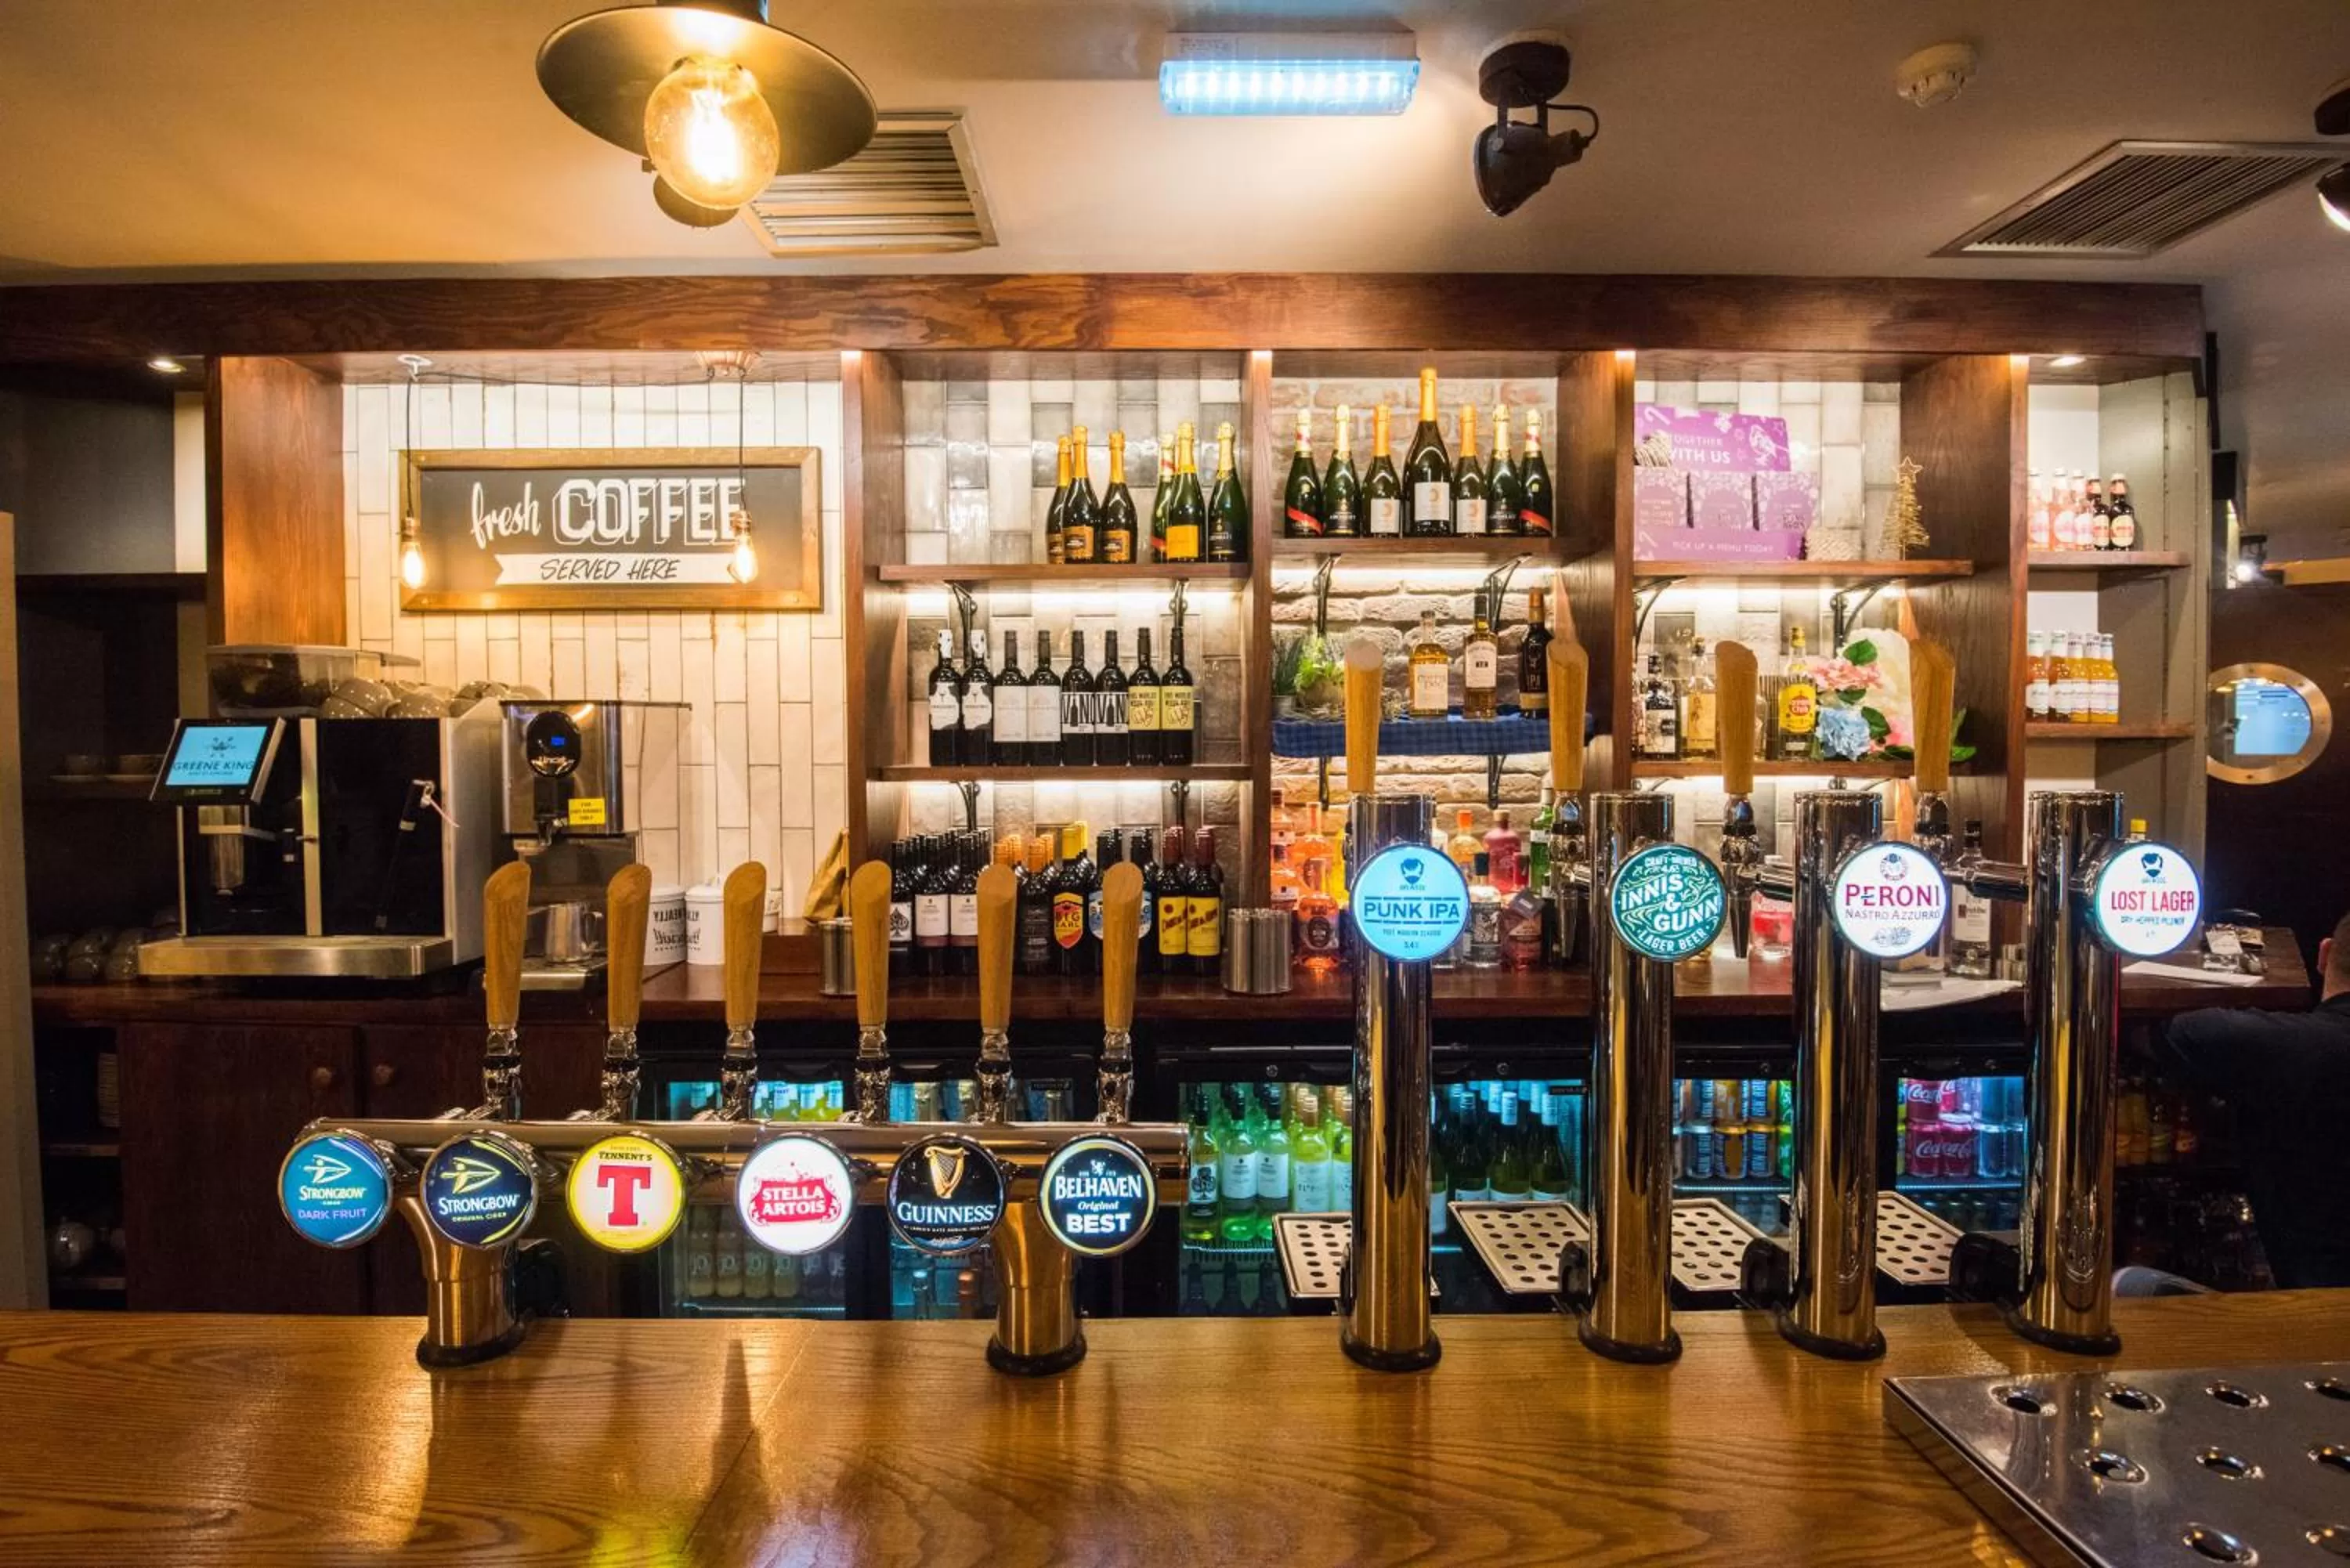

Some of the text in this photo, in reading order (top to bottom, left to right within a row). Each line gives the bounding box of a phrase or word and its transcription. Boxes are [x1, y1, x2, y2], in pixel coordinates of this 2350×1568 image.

[1710, 451, 1731, 464] US
[471, 478, 745, 550] fresh COFFEE
[540, 558, 682, 580] SERVED HERE
[1621, 873, 1683, 910] INNIS
[1845, 883, 1940, 907] PERONI
[2110, 891, 2195, 912] LOST LAGER
[1364, 902, 1460, 919] PUNK IPA
[1665, 893, 1682, 912] &
[1654, 896, 1719, 932] GUNN
[1637, 927, 1708, 952] LAGER BEER
[299, 1185, 367, 1201] STRONGBOW
[597, 1165, 652, 1227] T
[761, 1187, 825, 1201] STELLA
[1054, 1175, 1142, 1200] BELHAVEN
[298, 1208, 367, 1219] DARK FRUIT
[438, 1194, 519, 1215] STRONGBOW
[762, 1201, 826, 1215] ARTOIS
[897, 1202, 995, 1223] GUINNESS
[1078, 1201, 1120, 1212] Original
[1066, 1213, 1131, 1234] BEST
